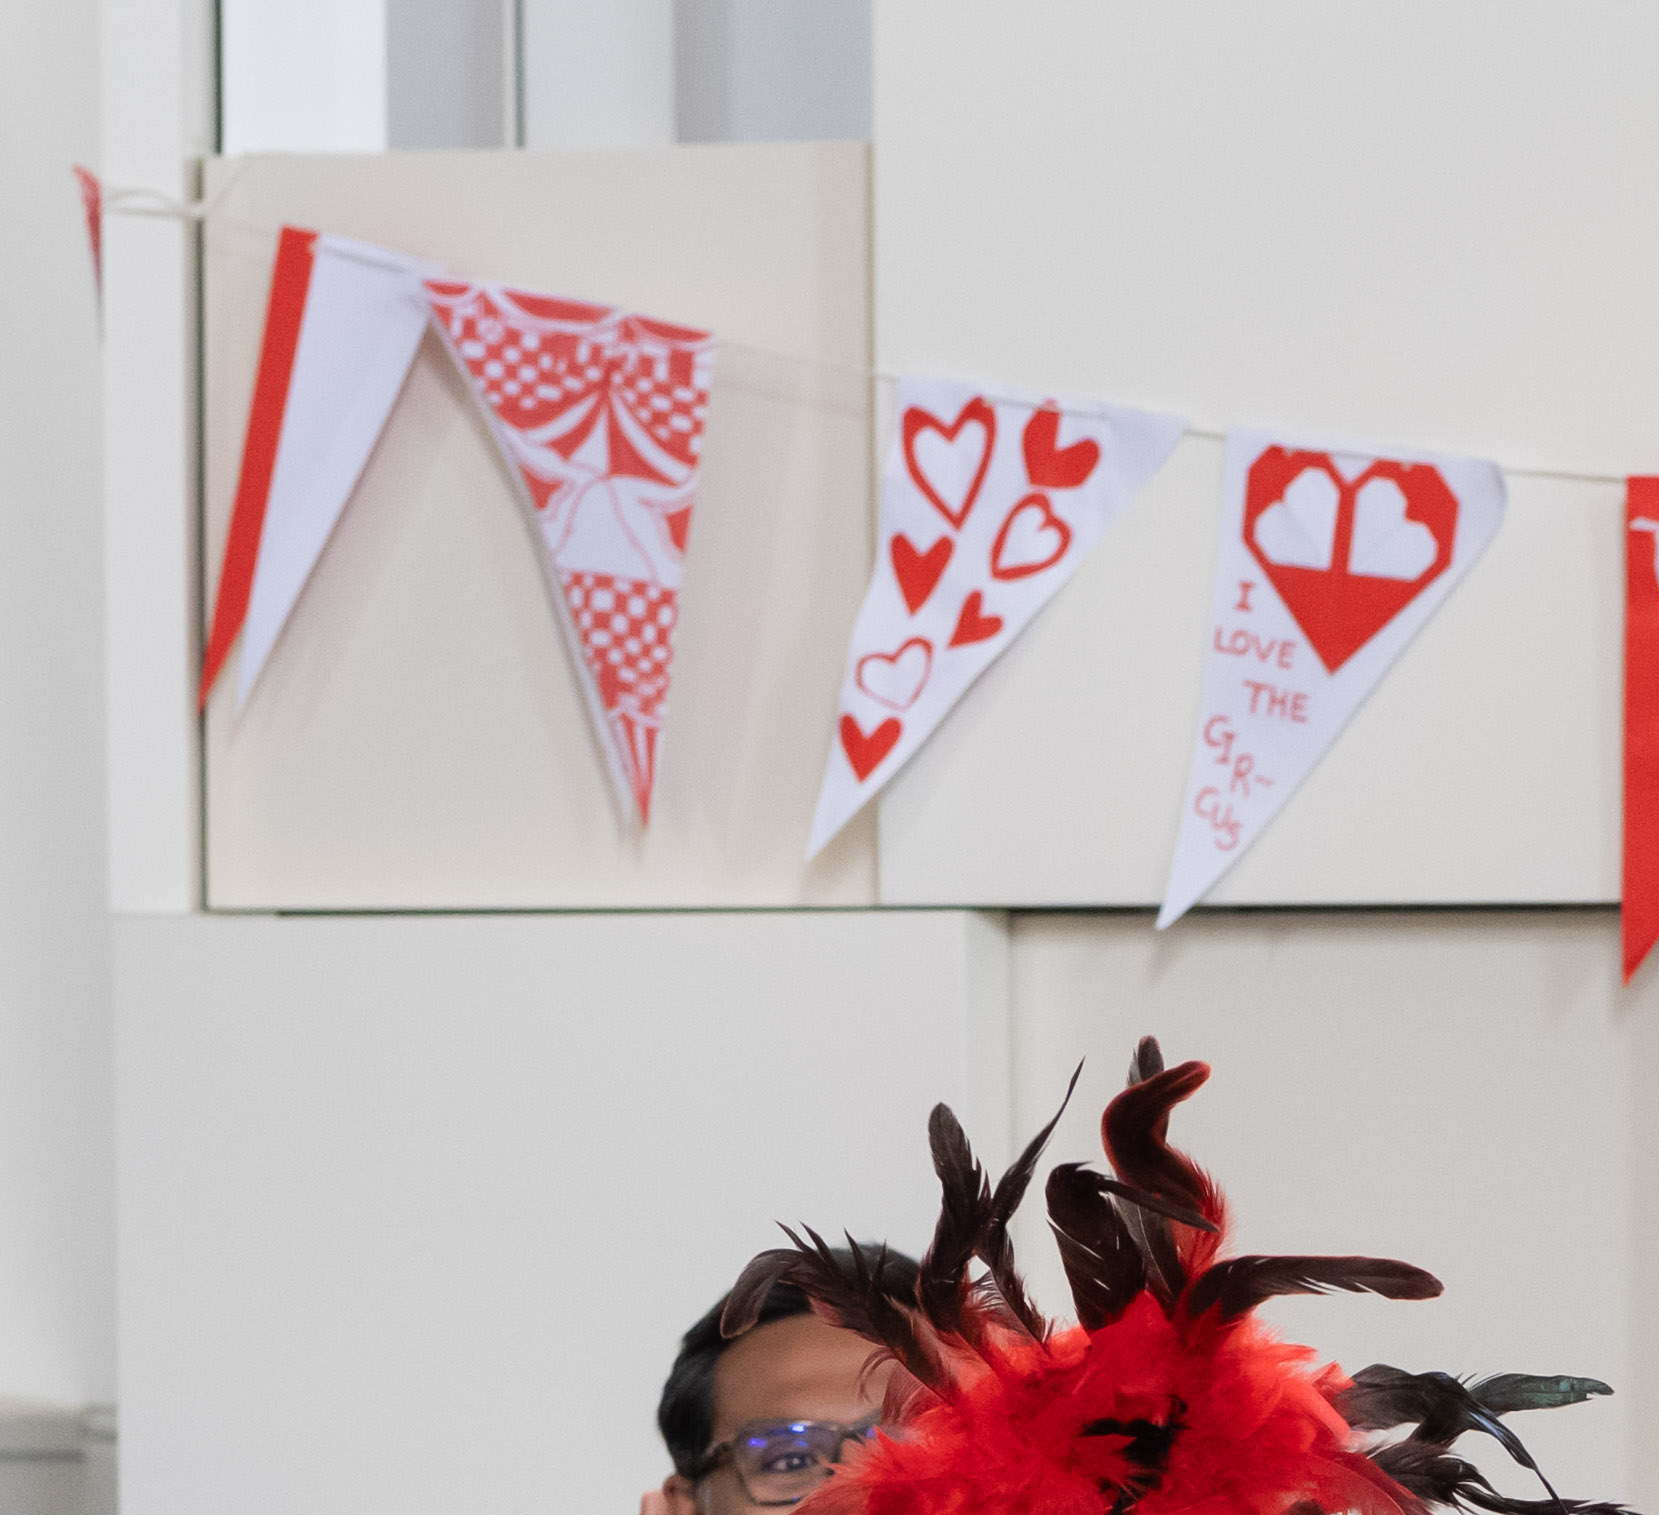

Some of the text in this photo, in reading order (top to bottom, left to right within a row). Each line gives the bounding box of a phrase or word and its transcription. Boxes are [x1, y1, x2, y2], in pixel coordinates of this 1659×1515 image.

[1234, 580, 1256, 612] I
[1213, 626, 1296, 669] LOVE
[1244, 679, 1310, 723] THE
[1194, 786, 1242, 850] CUS
